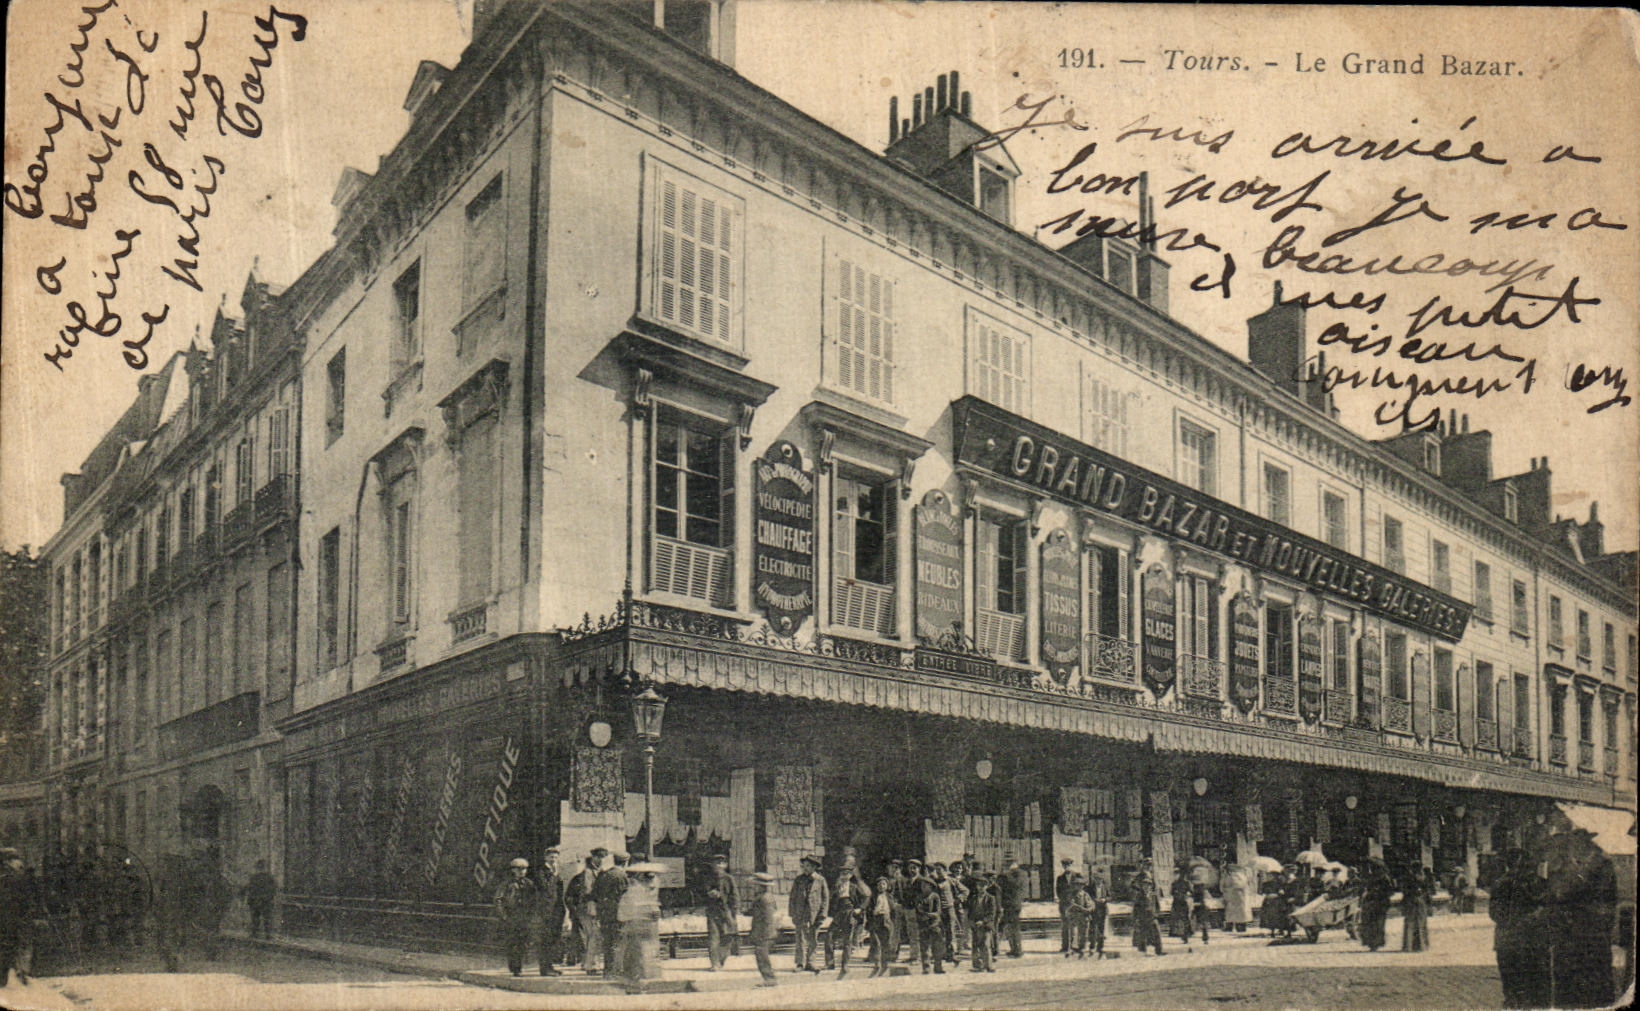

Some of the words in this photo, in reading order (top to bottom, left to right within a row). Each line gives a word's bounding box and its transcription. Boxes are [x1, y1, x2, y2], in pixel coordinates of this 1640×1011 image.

[1047, 142, 1139, 195] bon
[1262, 225, 1555, 293] beaucoup
[122, 304, 169, 369] de
[758, 519, 812, 554] CHAUFFAGE
[1011, 435, 1126, 511] GRAND
[1138, 486, 1231, 550] BAZAR
[1232, 530, 1257, 560] ET
[1258, 534, 1374, 600] NOUVELLES
[1379, 583, 1456, 632] GALERIES
[1043, 591, 1079, 618] TISSUS
[474, 737, 520, 888] OPTIQUE
